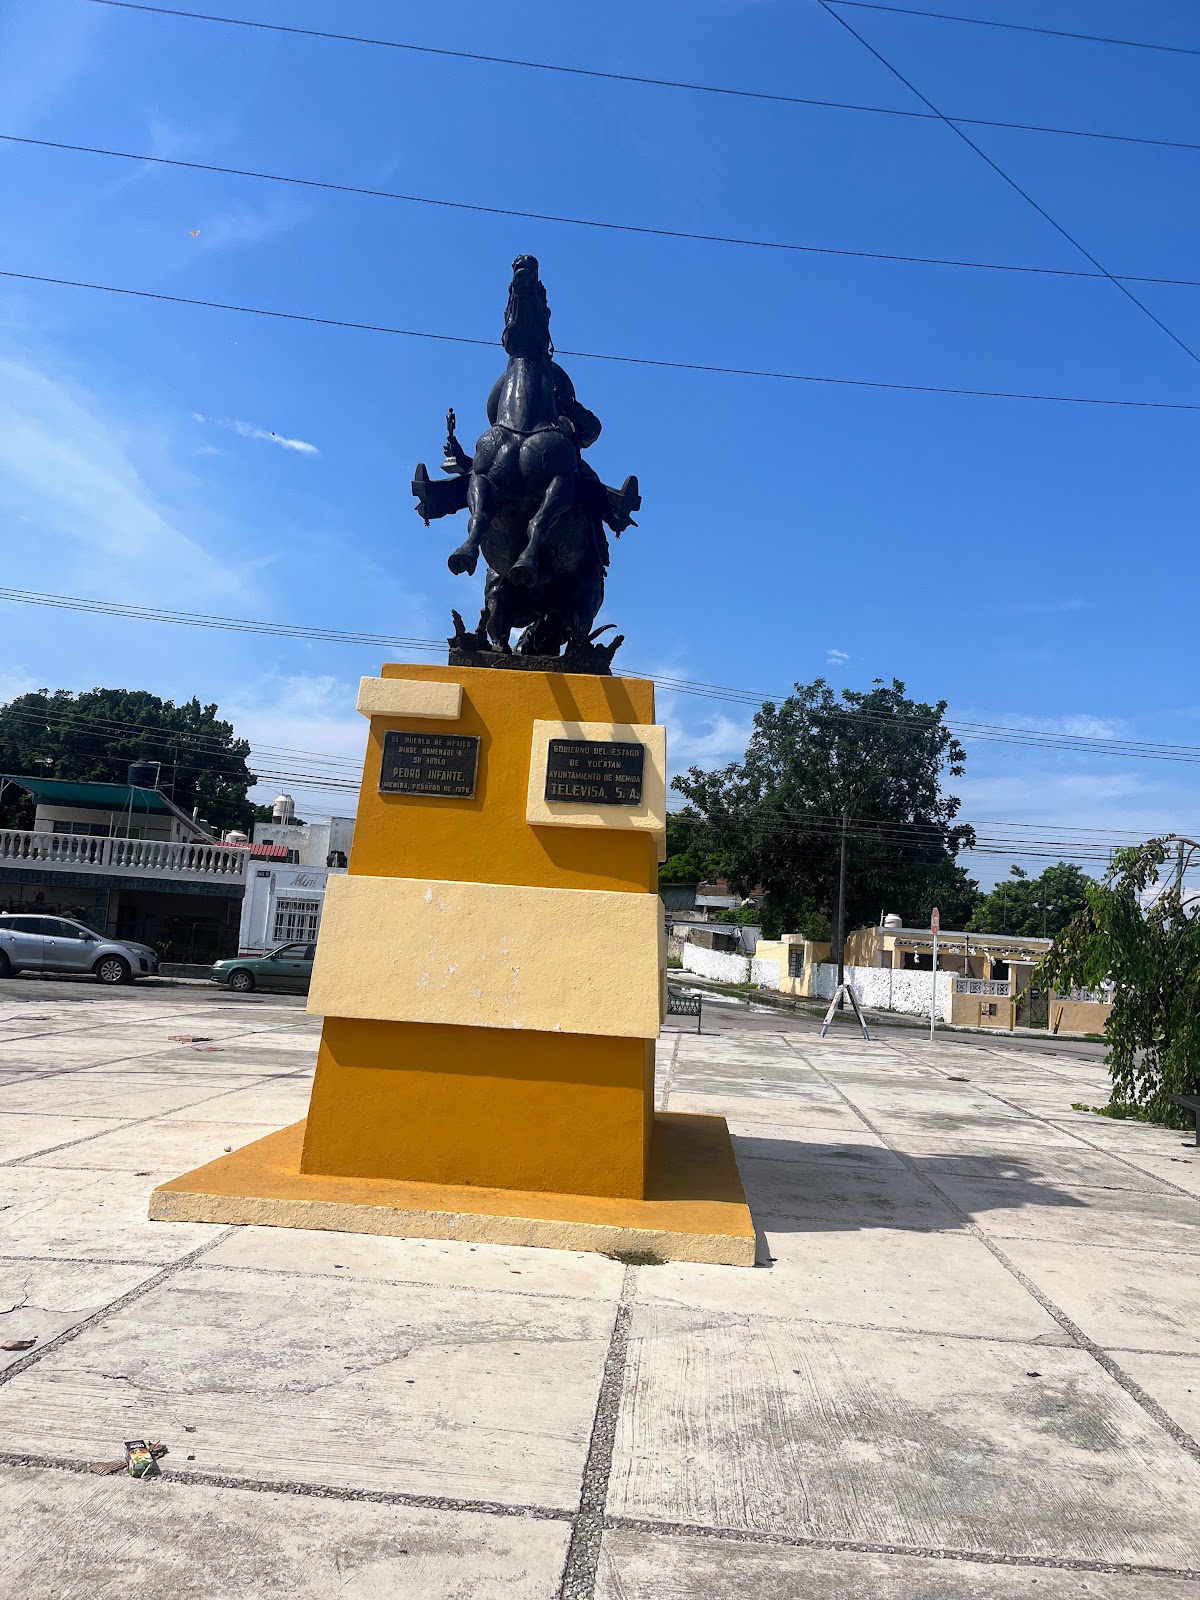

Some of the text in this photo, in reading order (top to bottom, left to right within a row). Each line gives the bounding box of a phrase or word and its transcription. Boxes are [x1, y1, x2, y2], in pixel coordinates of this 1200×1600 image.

[422, 747, 454, 756] HOMENAJE
[554, 746, 590, 754] GOBIERNO
[612, 748, 640, 756] ESTADO
[588, 760, 622, 768] YUCATAN
[394, 767, 464, 782] PEDRO INFANTE.
[549, 770, 600, 780] AYUNTAMIENTO
[616, 774, 640, 782] MERIDA
[551, 783, 639, 800] TELEVISA, S. A.
[290, 874, 318, 888] Mini
